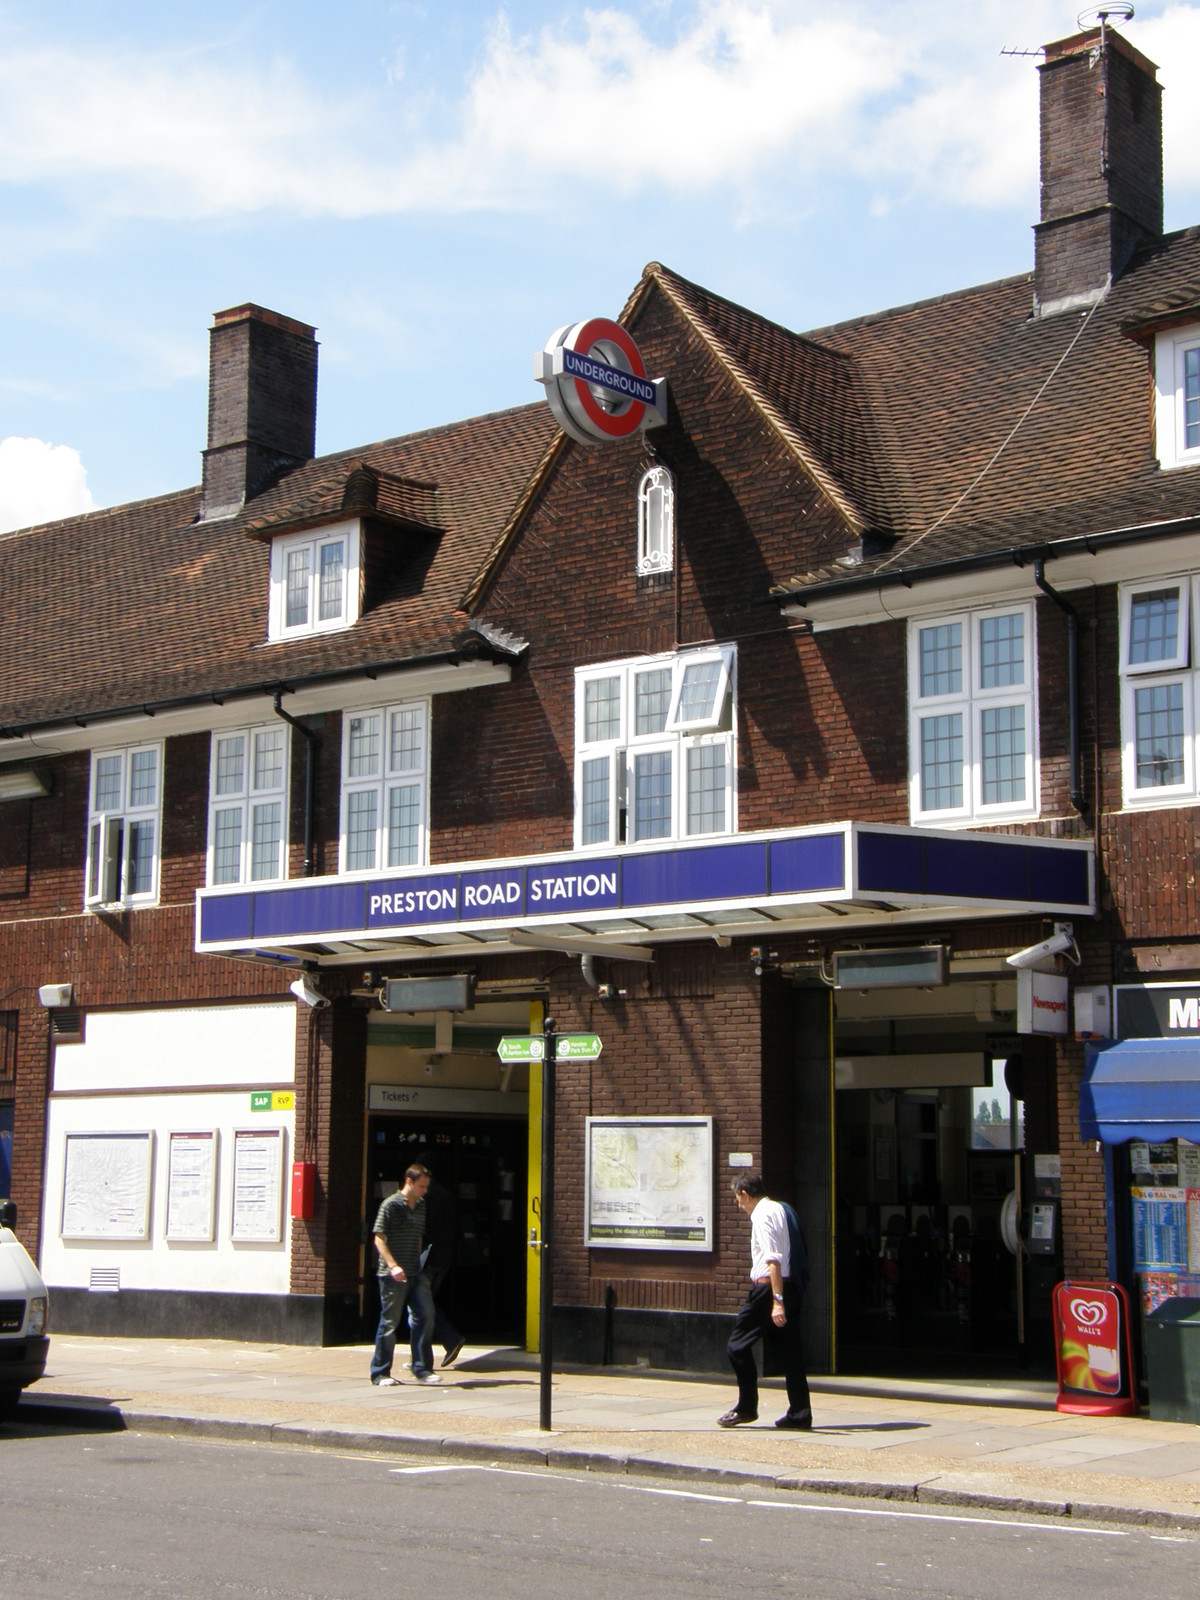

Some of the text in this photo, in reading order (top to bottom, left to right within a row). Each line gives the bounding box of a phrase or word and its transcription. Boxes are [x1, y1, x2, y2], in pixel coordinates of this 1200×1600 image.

[566, 355, 653, 399] UNDERGROUND
[370, 872, 617, 915] PRESTON ROAD STATION
[1031, 995, 1067, 1013] Newsagent
[1169, 998, 1200, 1029] M
[254, 1097, 269, 1106] SAP
[277, 1096, 290, 1105] RVP
[381, 1090, 410, 1102] Tickets
[1077, 1325, 1101, 1336] WALL'S
